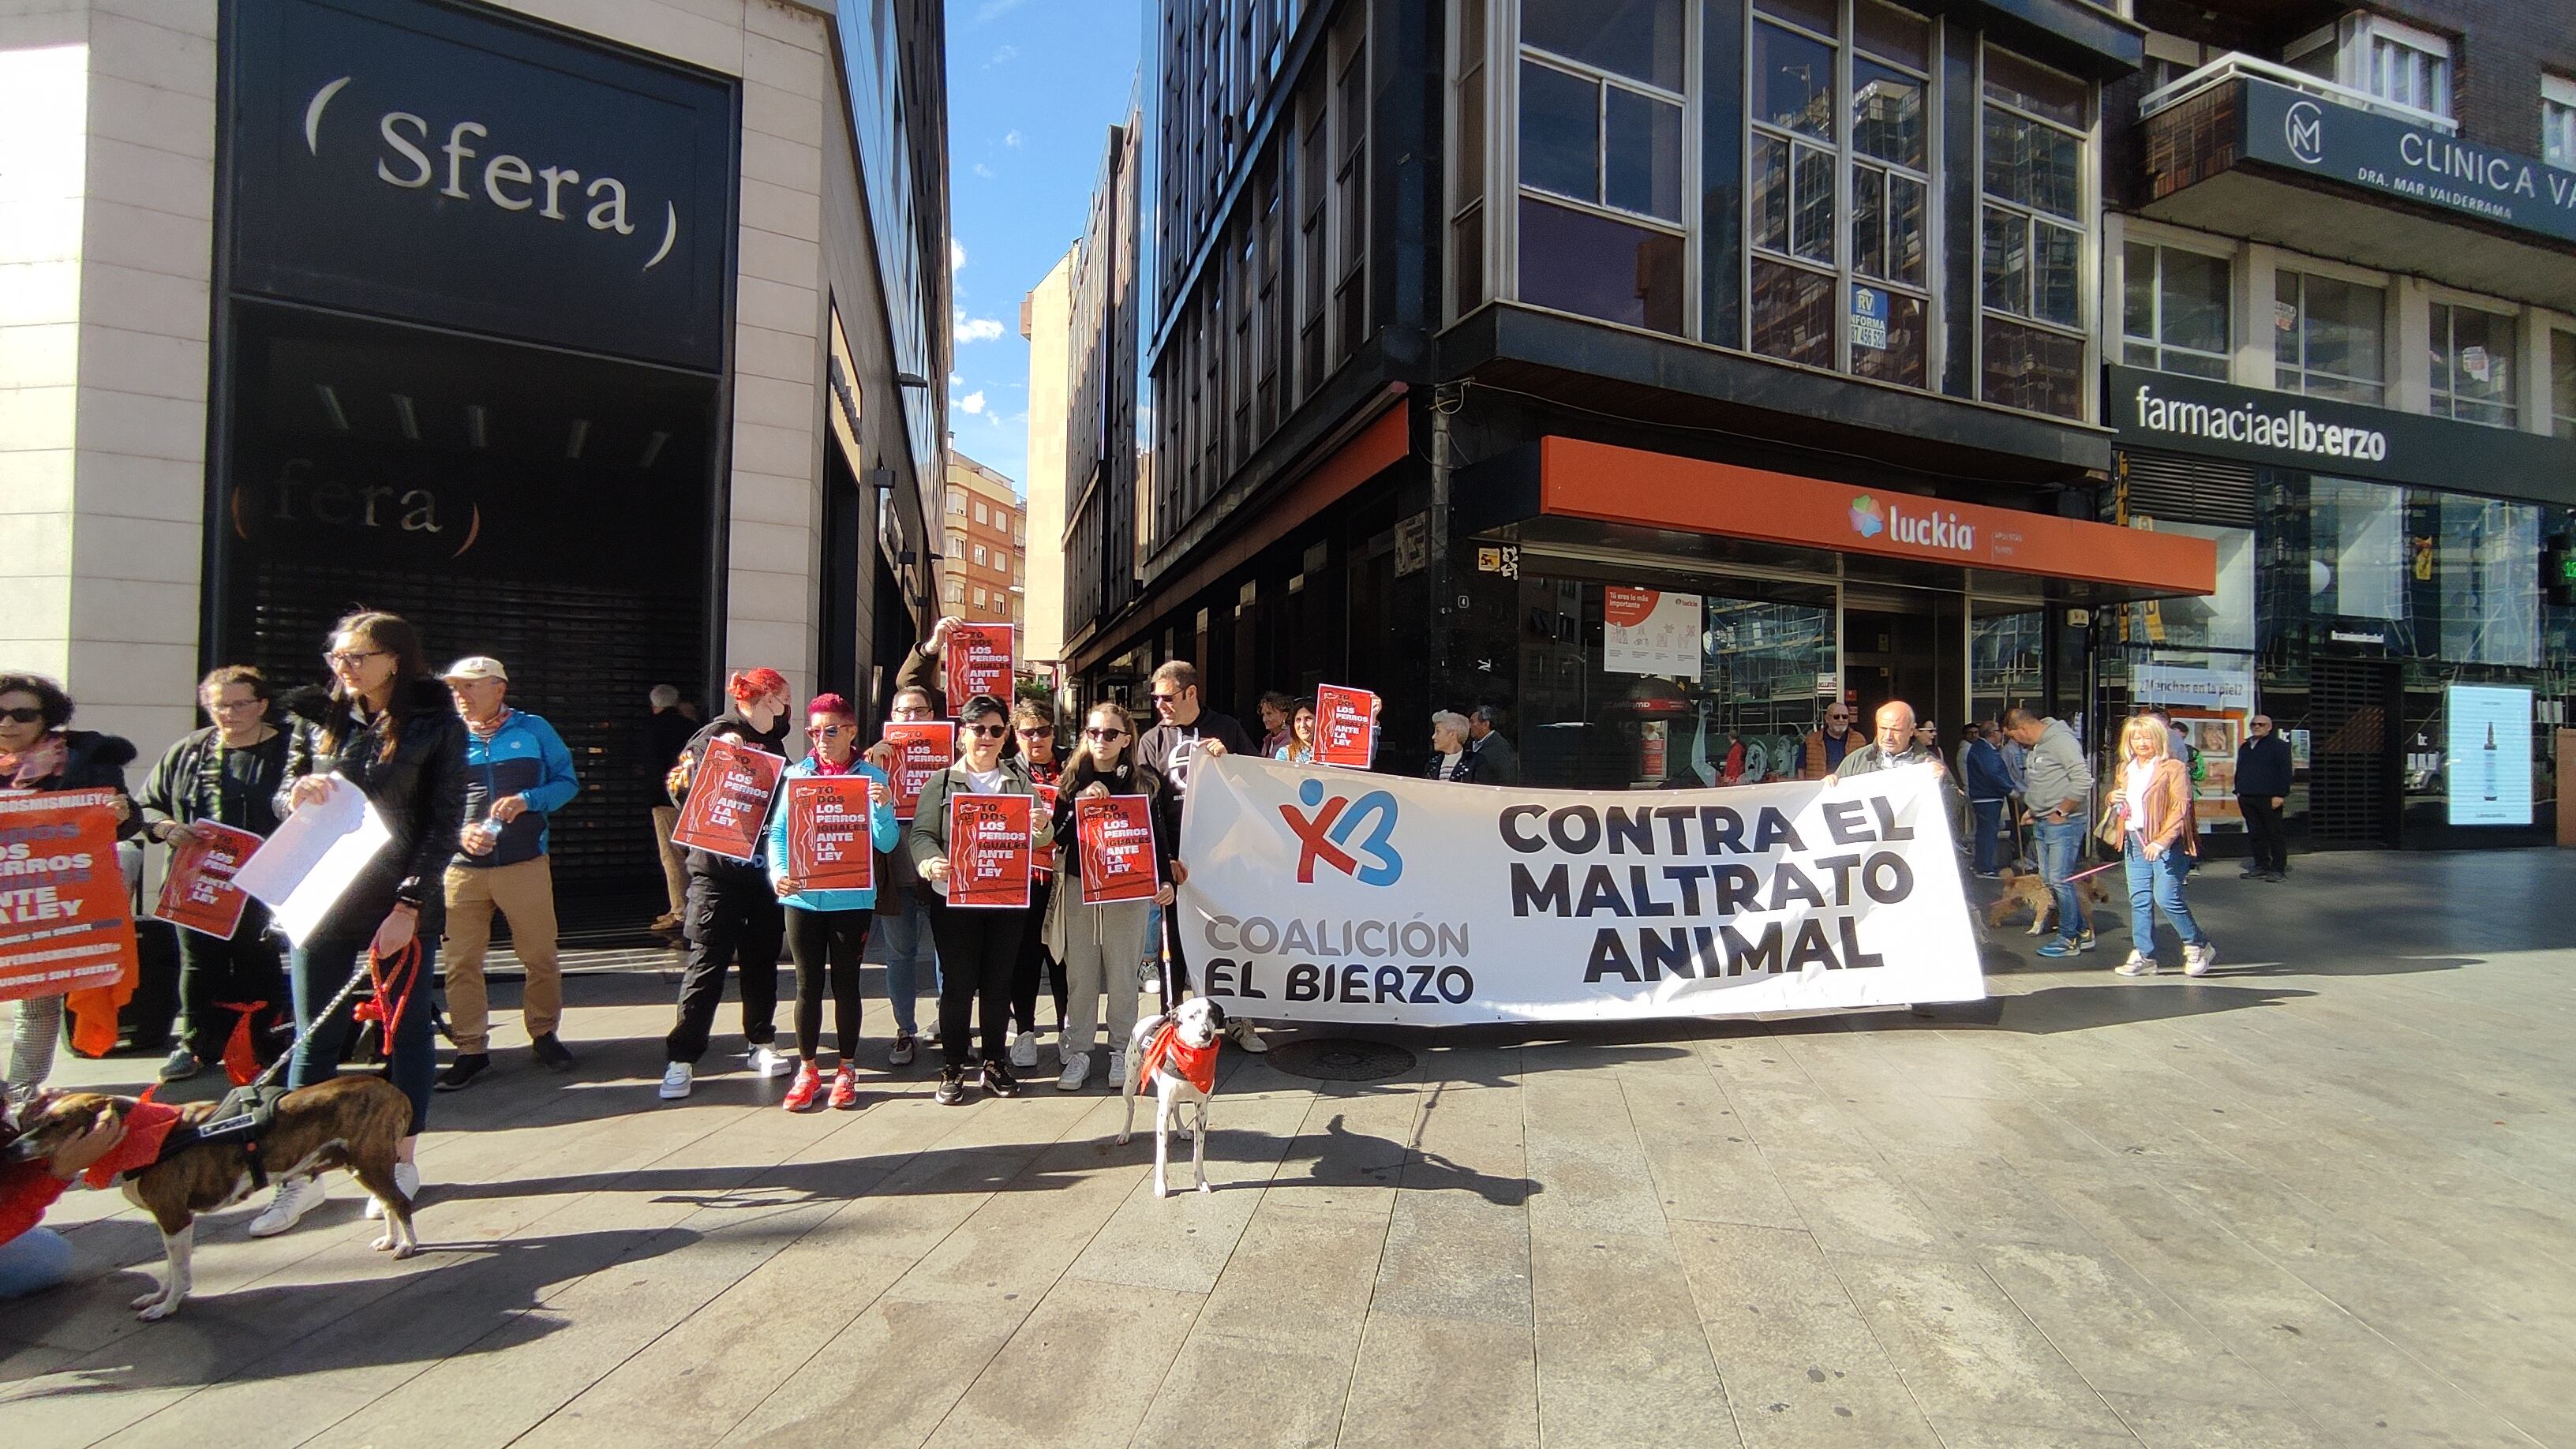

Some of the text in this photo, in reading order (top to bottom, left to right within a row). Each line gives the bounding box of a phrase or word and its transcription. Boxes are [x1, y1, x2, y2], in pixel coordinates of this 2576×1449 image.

[378, 111, 635, 235] Sfera
[2358, 167, 2512, 219] DRA. MAR VALDERRAMA
[1858, 294, 1873, 311] RV
[1851, 314, 1885, 330] NFORMA
[1861, 328, 1871, 345] 456
[1890, 504, 1973, 551] luckia
[2192, 685, 2205, 694] en
[2207, 683, 2216, 695] la
[1335, 713, 1368, 722] PERROS
[1335, 725, 1360, 734] ANTE
[907, 746, 930, 754] LOS
[728, 771, 753, 784] LOS
[724, 781, 769, 799] PERROS
[718, 797, 752, 813] ANTE
[817, 796, 845, 804] DOS
[713, 806, 732, 817] LA
[816, 804, 844, 814] LOS
[710, 814, 738, 826] LEY
[816, 814, 866, 823] PERROS
[979, 822, 1005, 830] LOS
[1103, 820, 1129, 829] LOS
[1499, 796, 1915, 856] CONTRA EL
[817, 833, 854, 842] ANTE
[979, 831, 1026, 841] PERROS
[1104, 828, 1148, 838] PERROS
[817, 842, 836, 852] LA
[1106, 845, 1140, 856] ANTE
[817, 852, 844, 861] LEY
[978, 850, 1014, 859] ANTE
[1106, 856, 1124, 864] LA
[977, 859, 996, 867] LA
[1107, 863, 1132, 873] LEY
[977, 868, 1003, 877] LEY
[1510, 851, 1915, 918] MALTRATO
[0, 886, 57, 907] NTE
[1204, 912, 1469, 958] COALICIÓN
[1583, 916, 1885, 983] ANIMAL
[1205, 958, 1473, 1004] EL BIERZO
